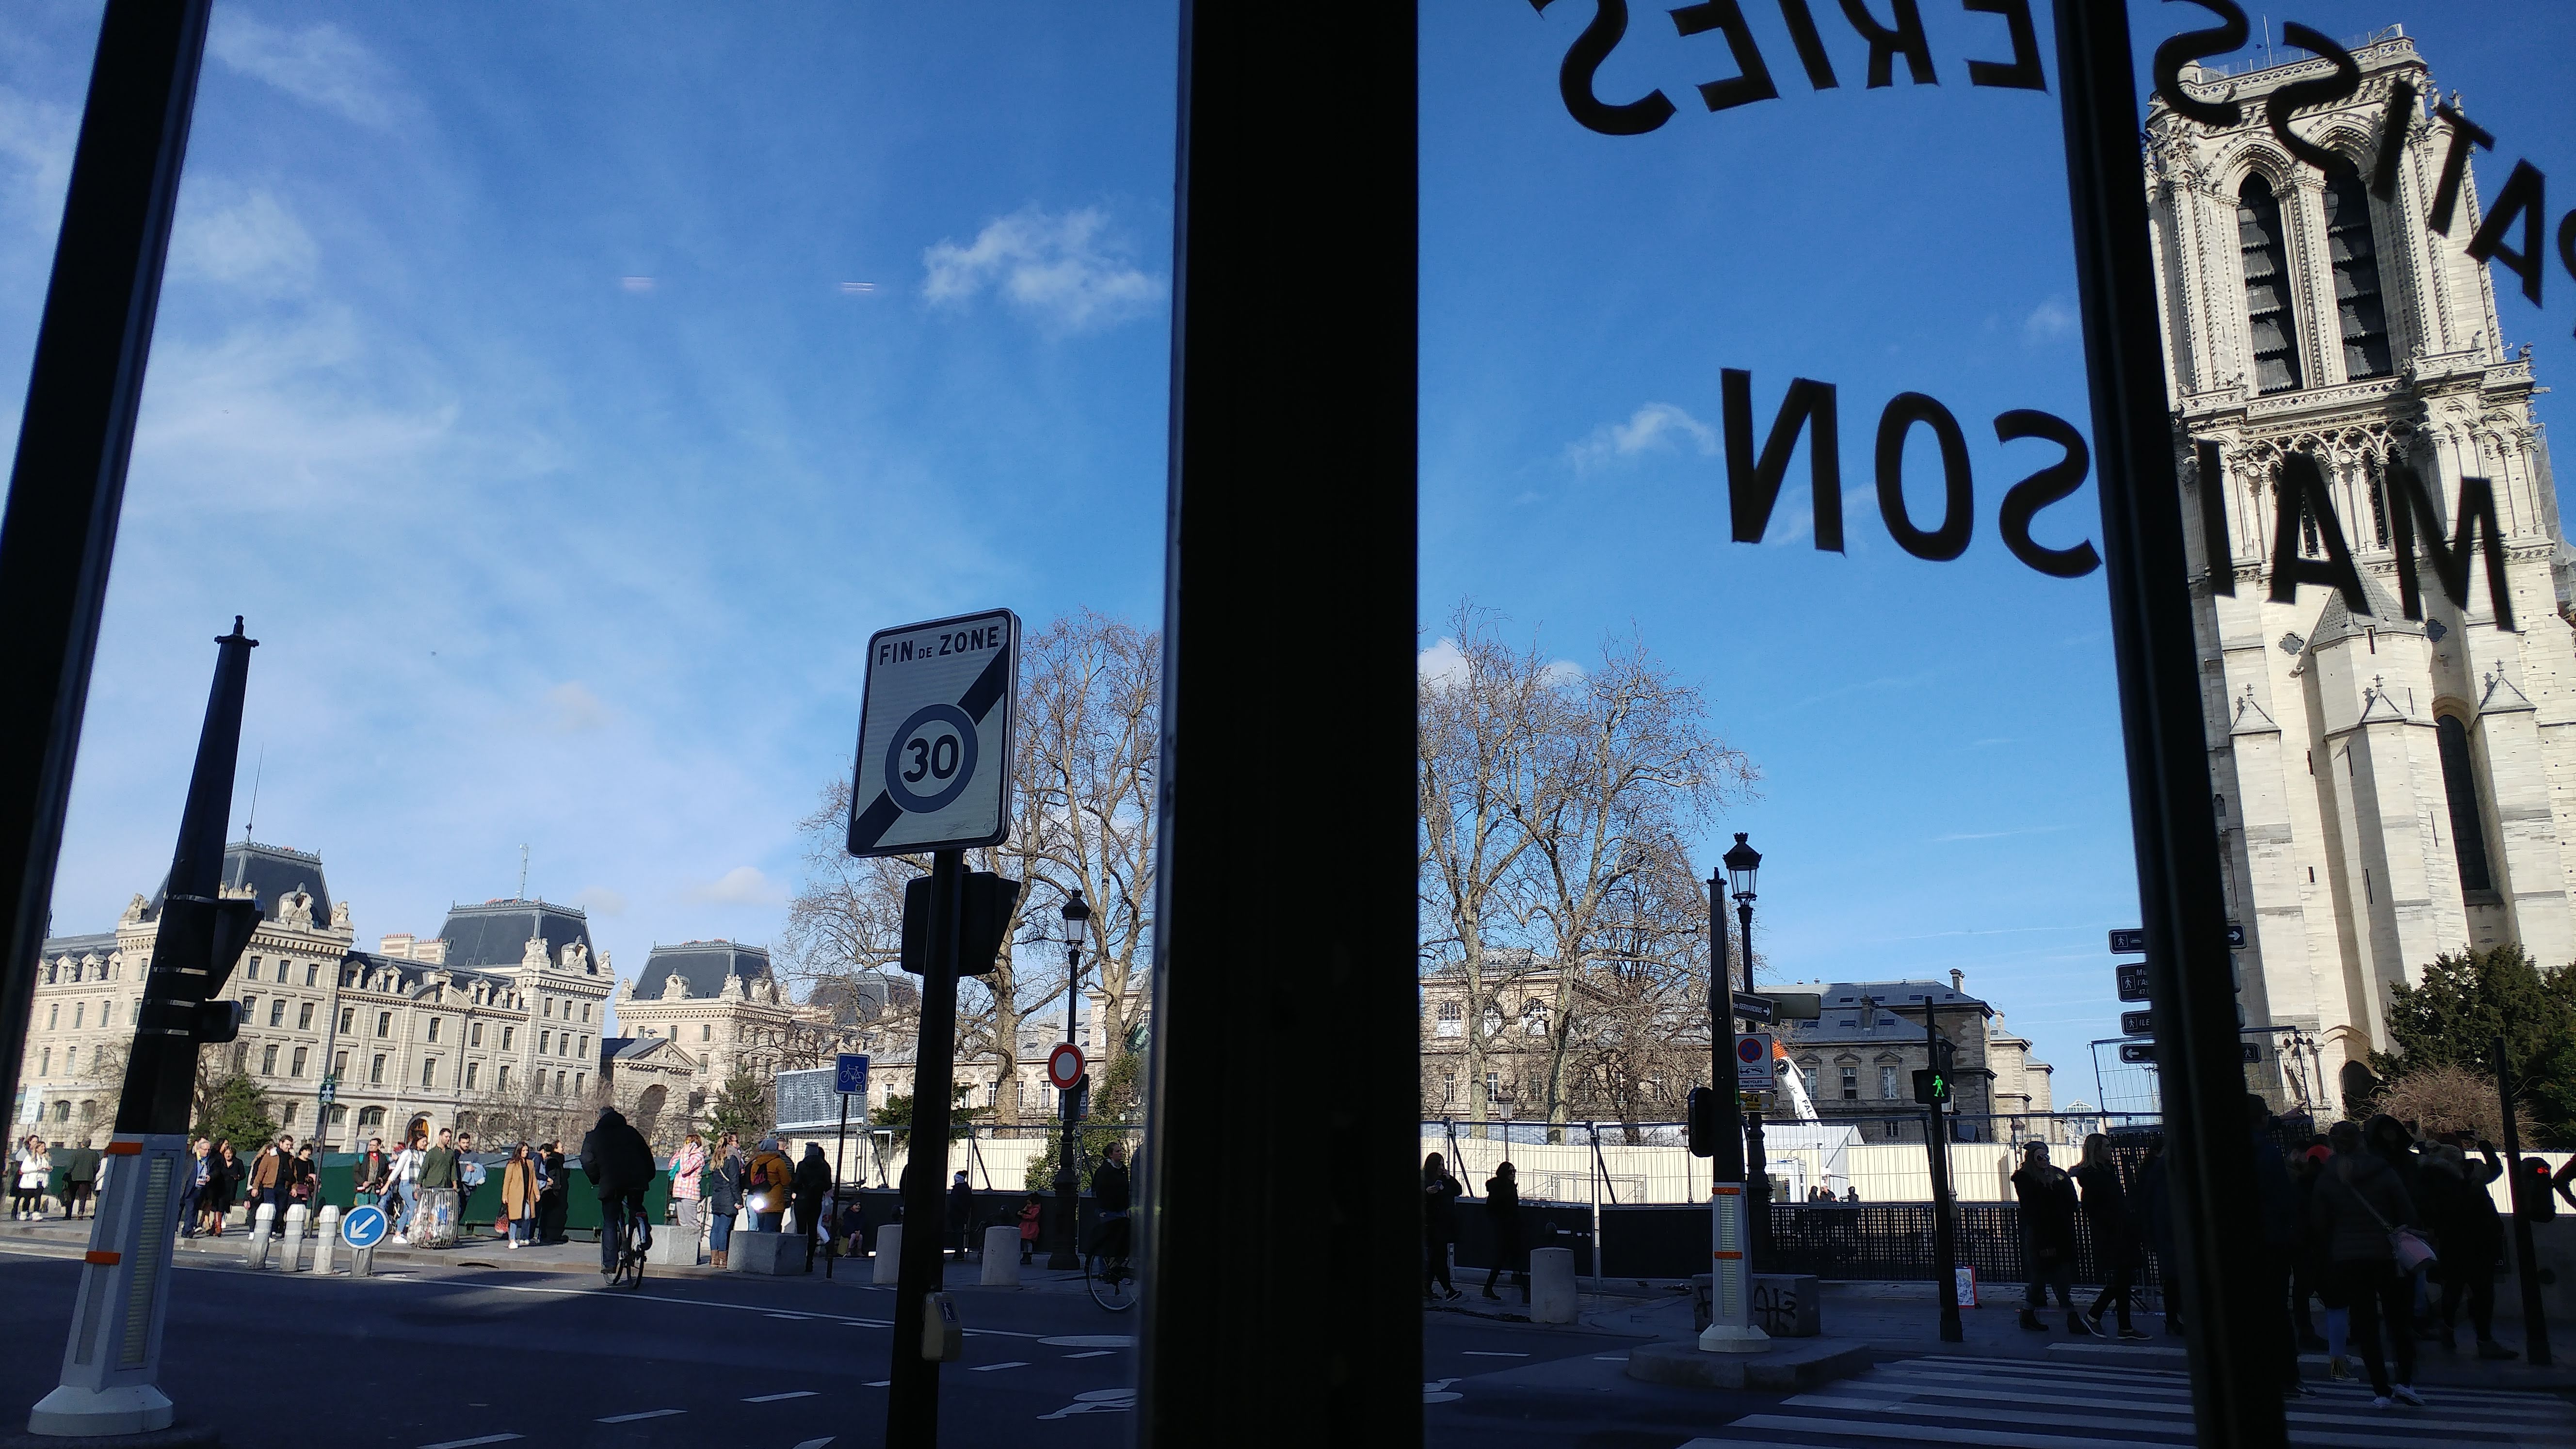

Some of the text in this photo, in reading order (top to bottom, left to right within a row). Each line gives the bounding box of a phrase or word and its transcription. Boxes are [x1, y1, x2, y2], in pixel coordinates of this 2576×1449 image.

[879, 626, 999, 666] FIN DE ZONE
[902, 734, 959, 783] 30
[1739, 1002, 1763, 1014] BERNARDINS
